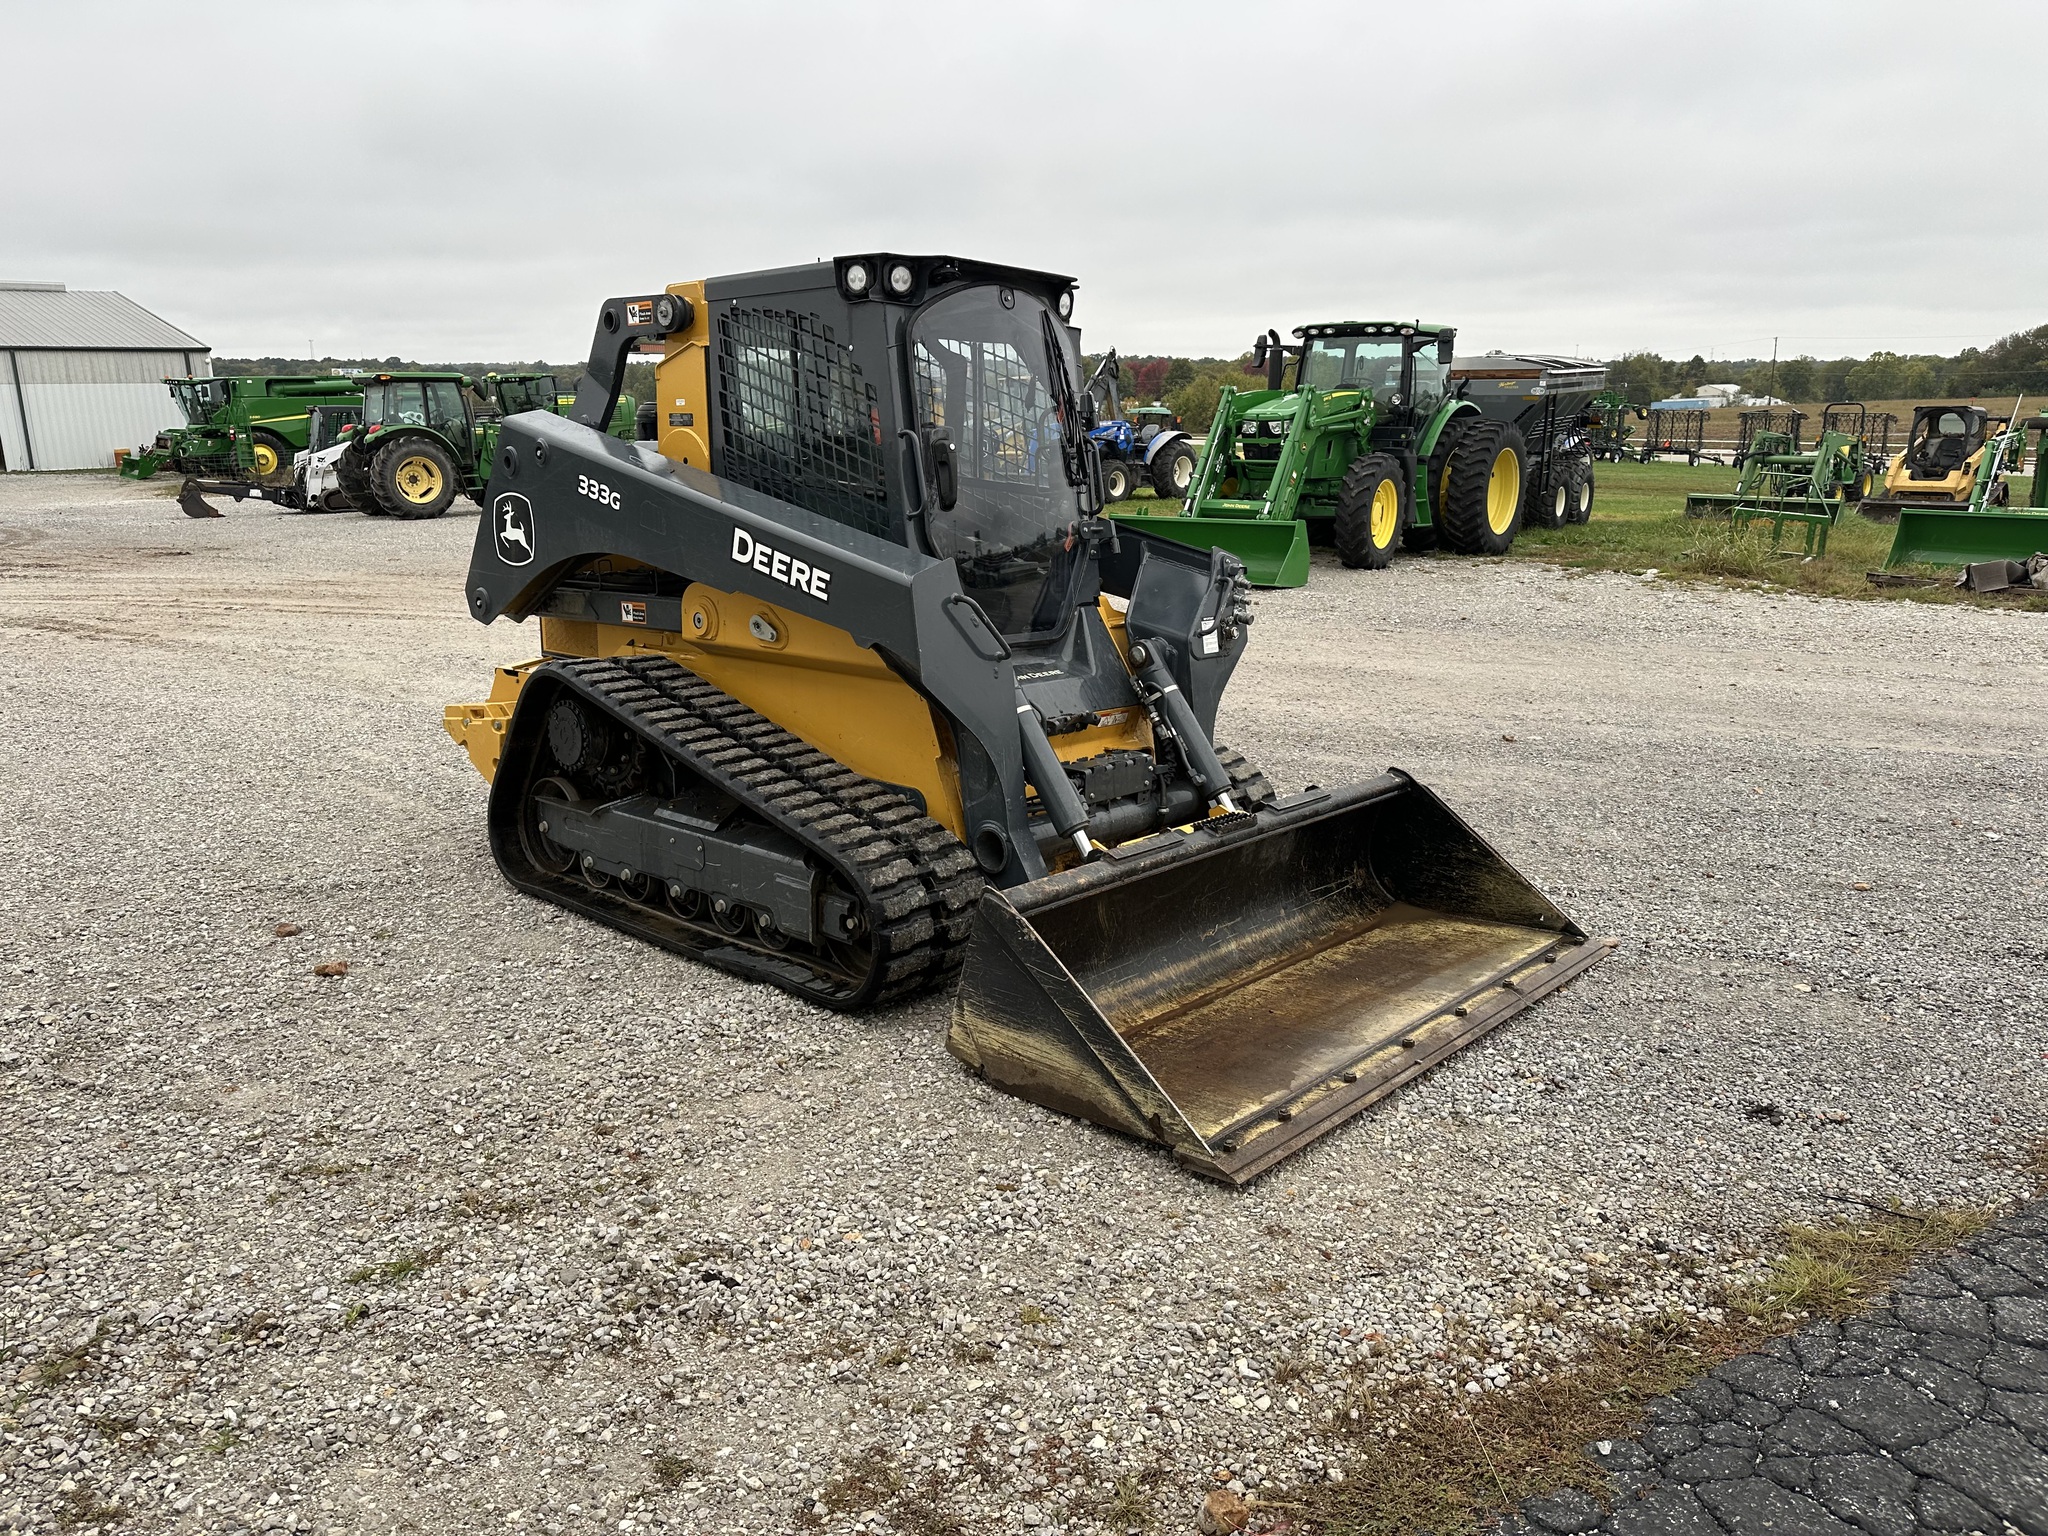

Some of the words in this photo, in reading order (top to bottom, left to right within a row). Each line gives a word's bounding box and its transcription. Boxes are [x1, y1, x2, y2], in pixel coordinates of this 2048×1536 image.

[577, 474, 621, 511] 333G
[731, 526, 831, 602] DEERE
[1027, 669, 1065, 679] DEERE
